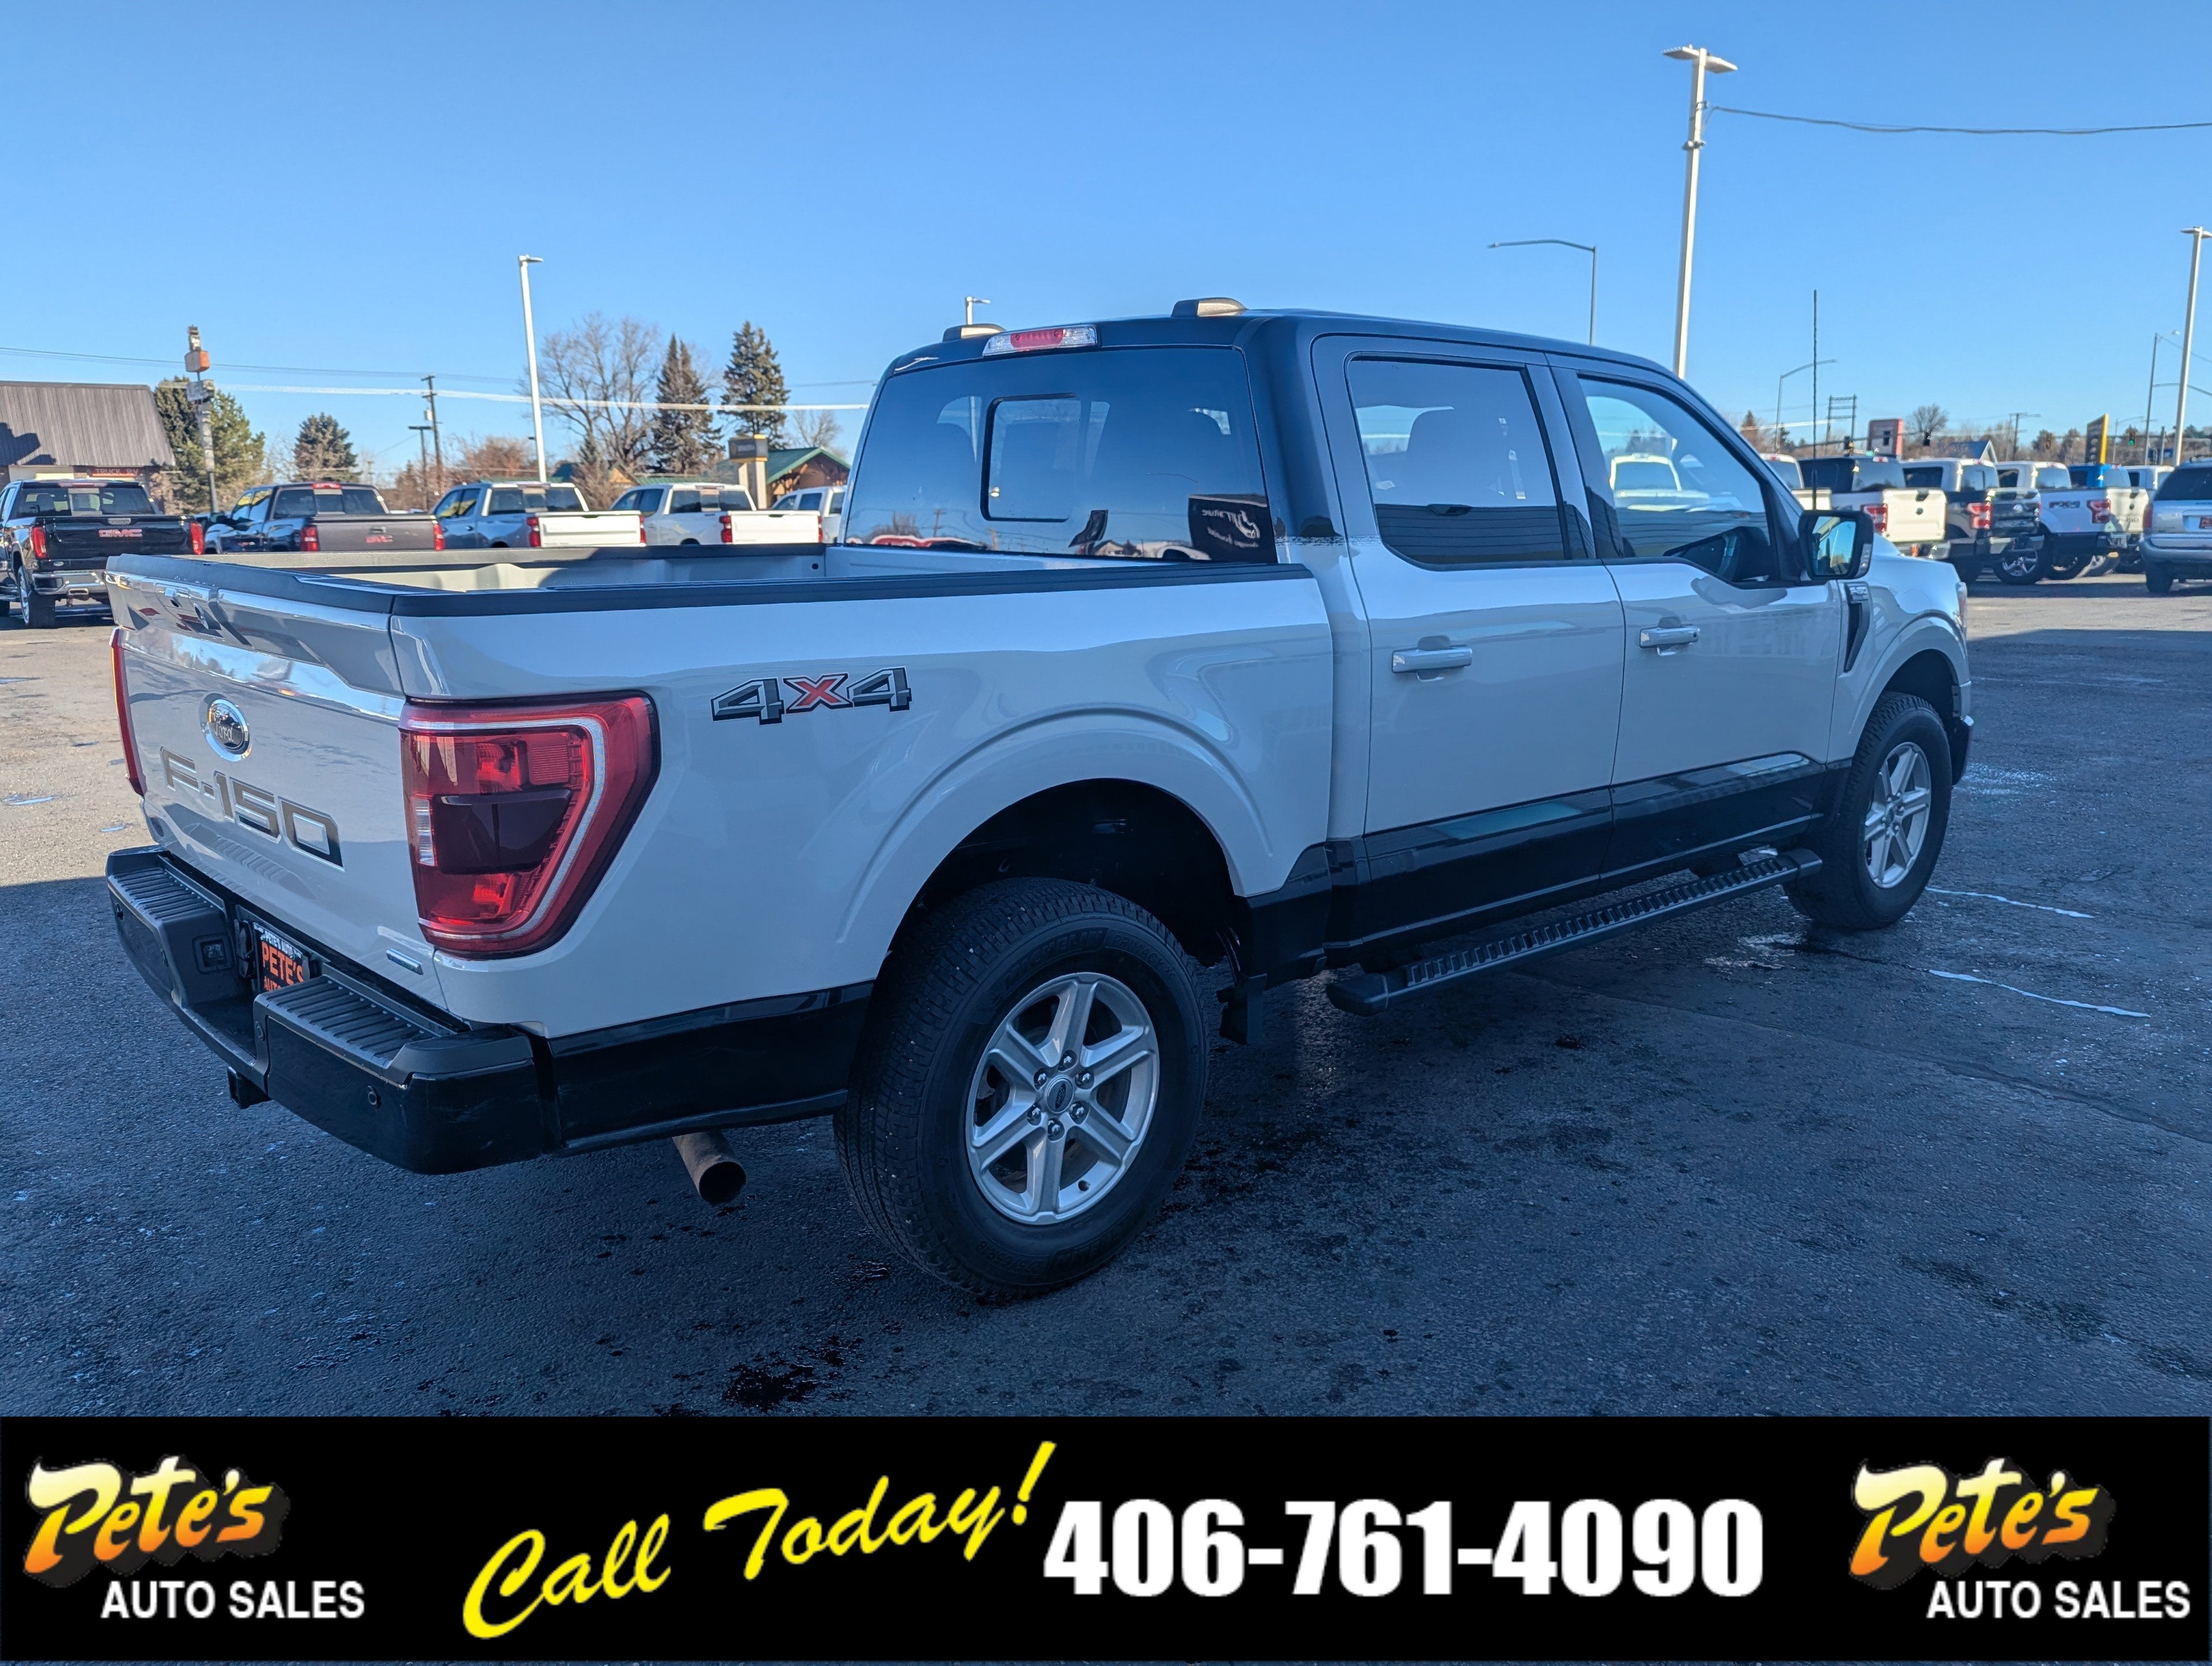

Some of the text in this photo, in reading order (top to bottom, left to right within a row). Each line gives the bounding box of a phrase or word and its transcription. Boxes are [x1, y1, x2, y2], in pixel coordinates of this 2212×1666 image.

[99, 529, 143, 537] GMC
[160, 746, 345, 872] F-150
[262, 941, 304, 986] PETE'S
